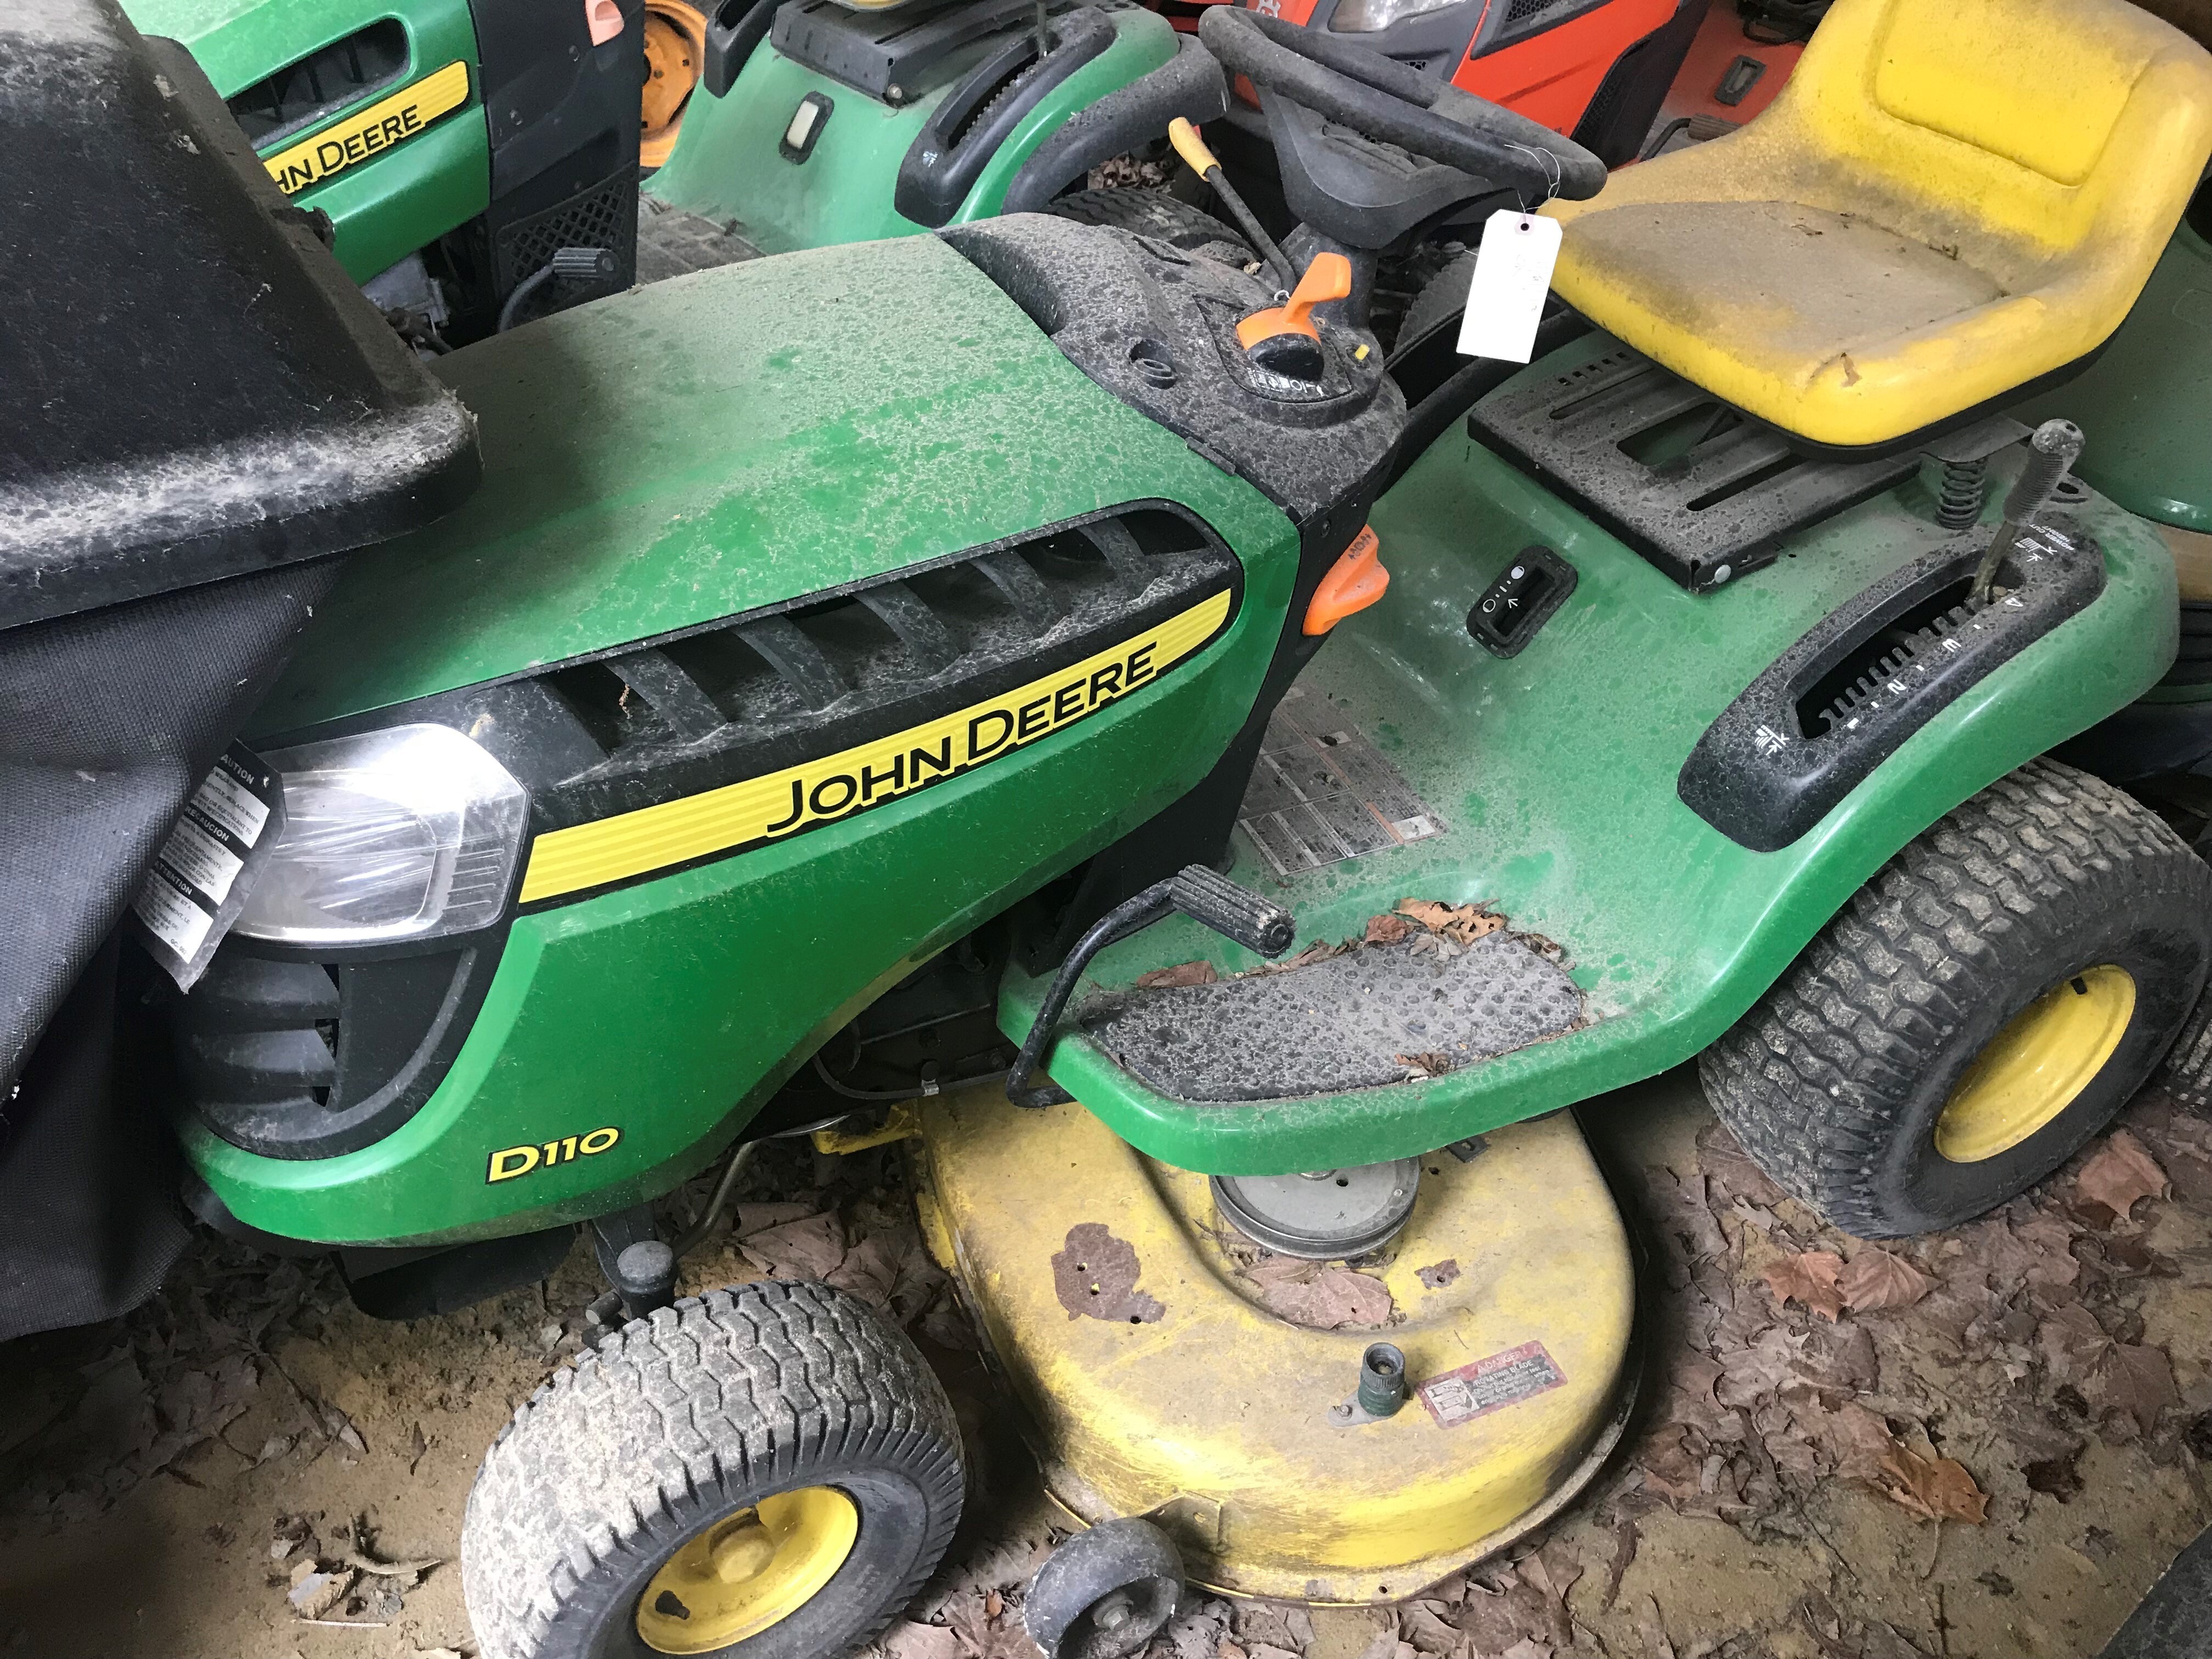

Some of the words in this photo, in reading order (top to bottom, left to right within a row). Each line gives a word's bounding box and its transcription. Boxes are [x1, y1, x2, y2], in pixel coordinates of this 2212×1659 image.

[277, 159, 313, 191] HN
[317, 104, 422, 172] DEERE
[2029, 524, 2045, 533] CUT
[2045, 533, 2074, 550] MOWER
[1887, 679, 1906, 694] 2
[768, 736, 951, 833] JOHN
[968, 641, 1157, 762] DEERE
[220, 752, 255, 784] AUTION
[184, 805, 229, 842] RECAUCION
[489, 1128, 619, 1182] D110
